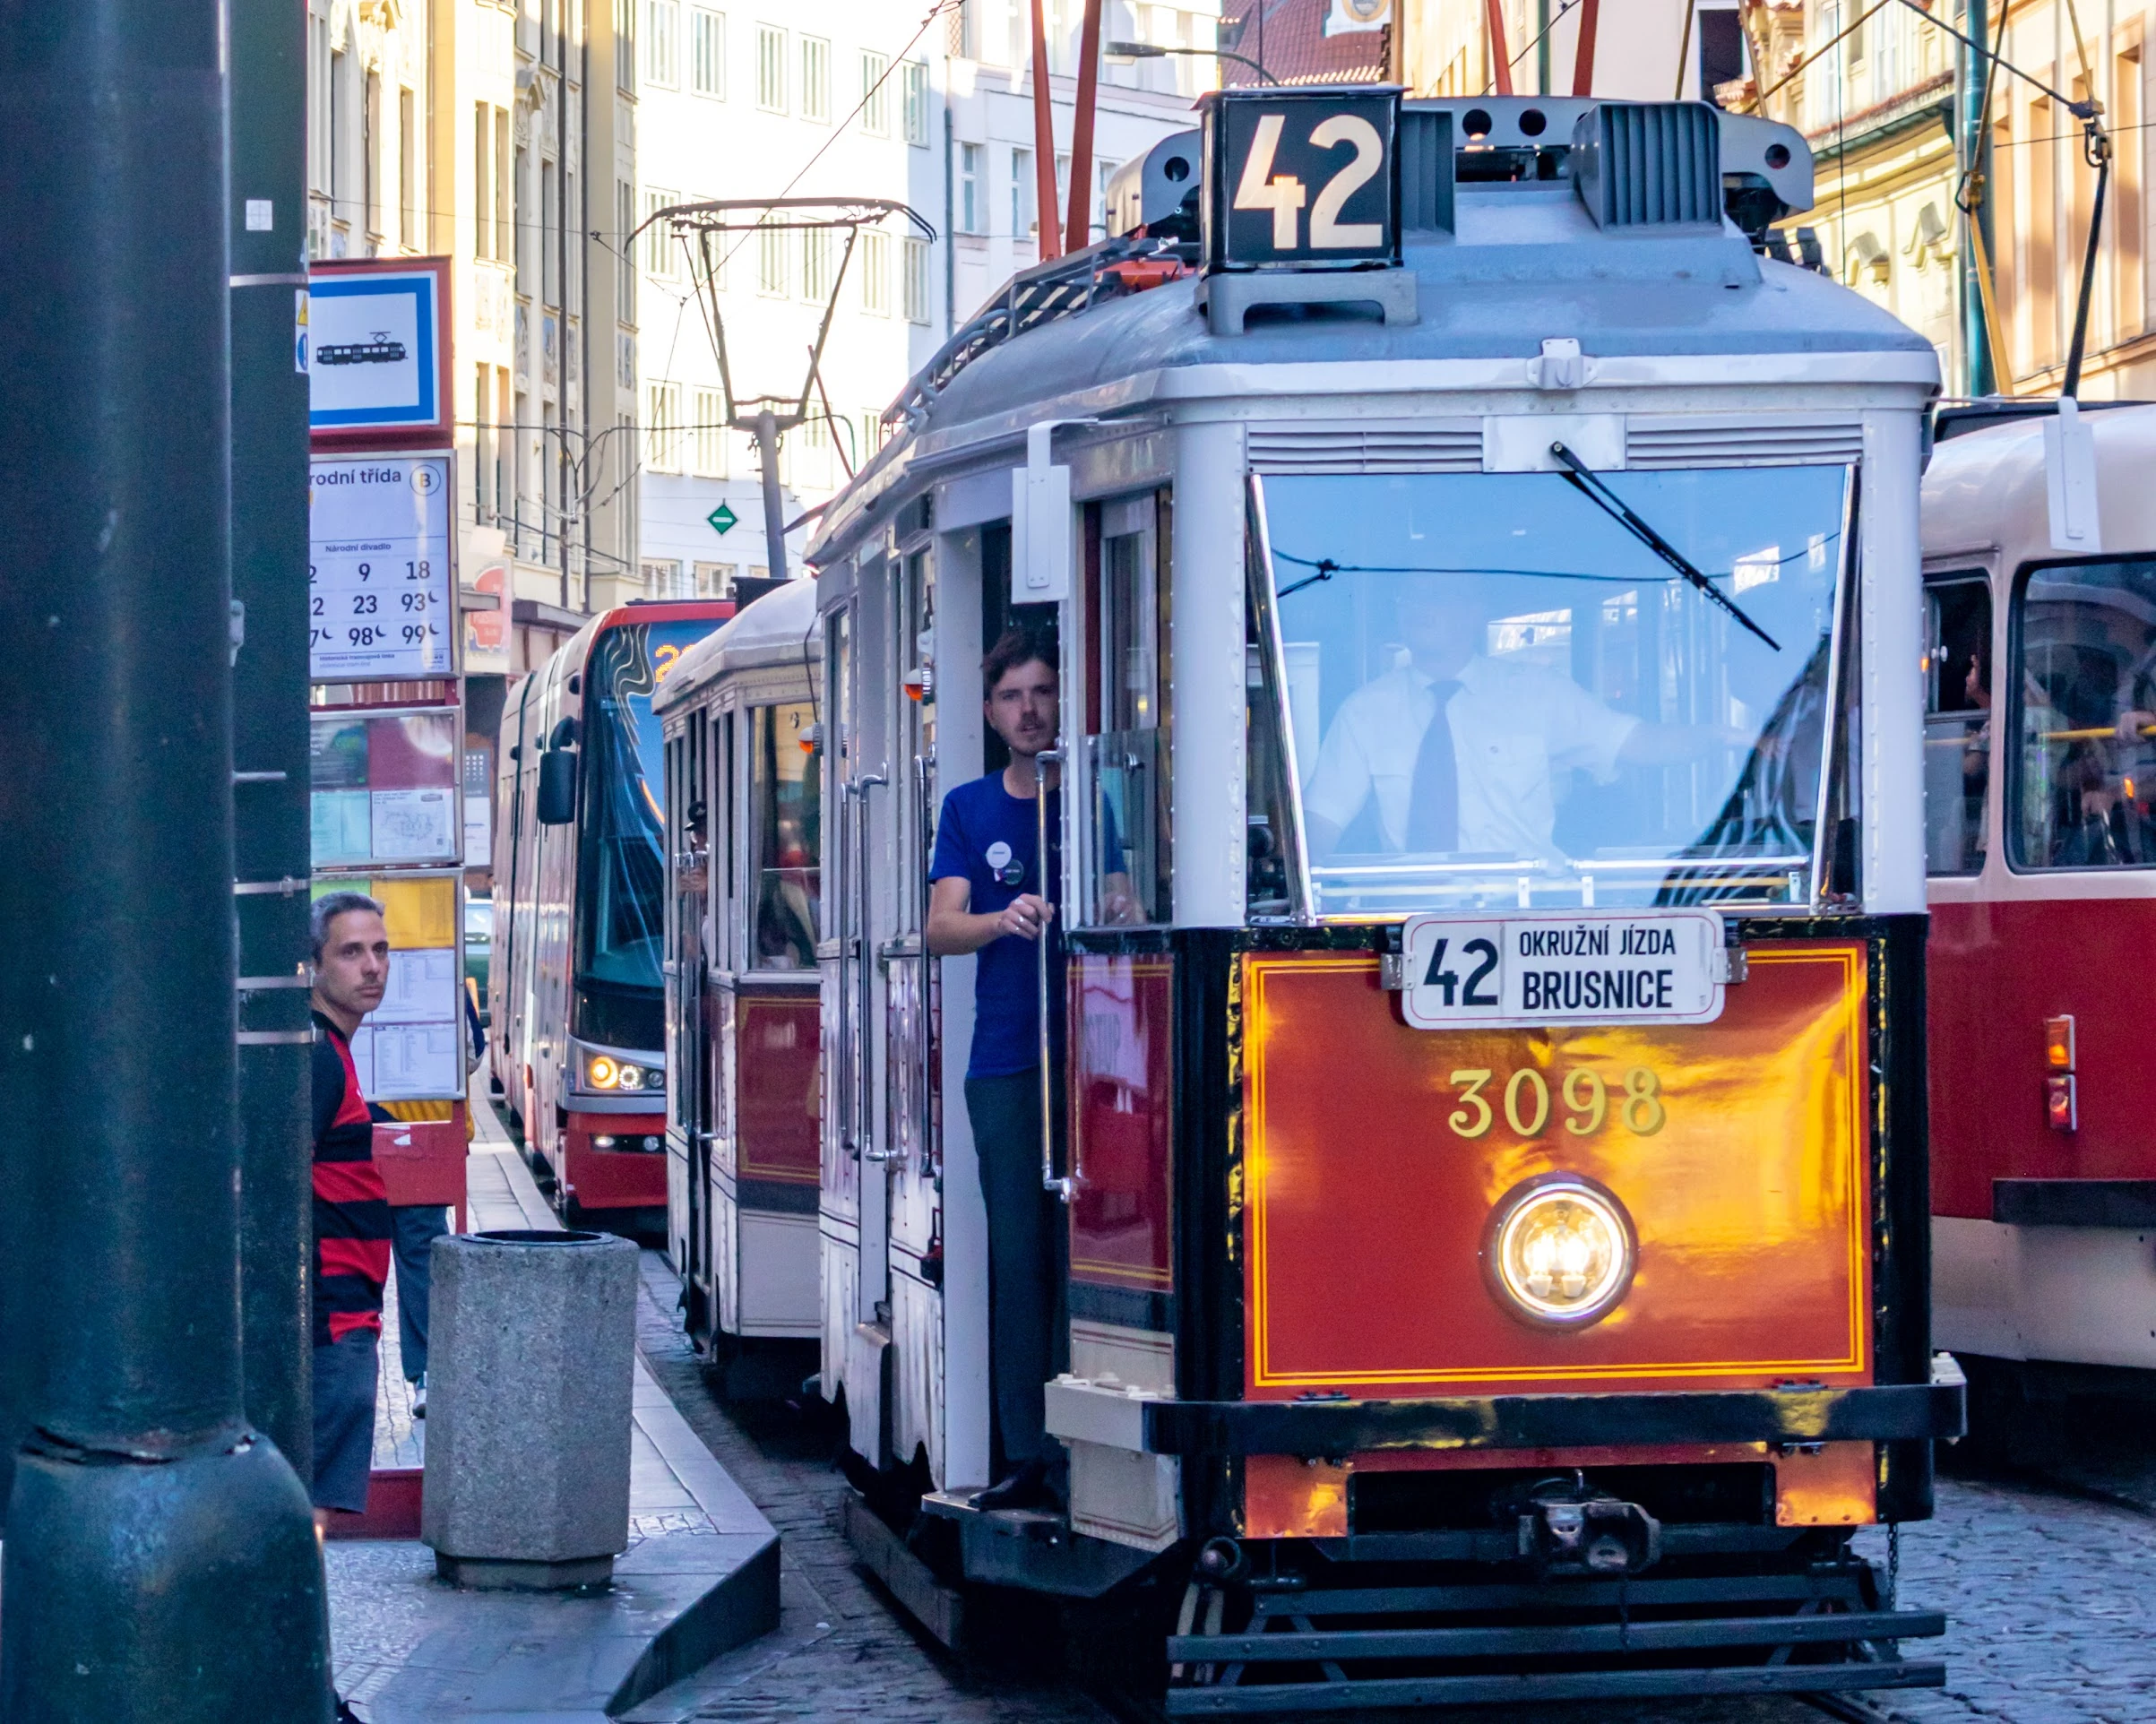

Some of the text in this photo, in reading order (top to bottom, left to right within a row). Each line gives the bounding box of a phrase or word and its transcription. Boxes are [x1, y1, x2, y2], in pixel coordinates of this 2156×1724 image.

[1233, 114, 1384, 250] 42
[360, 468, 401, 484] třída
[419, 472, 431, 488] B
[325, 543, 392, 553] Národní divadlo
[358, 563, 371, 582] 9
[406, 561, 430, 580] 18
[352, 595, 378, 615] 23
[401, 592, 426, 613] 93
[349, 627, 374, 647] 98
[401, 625, 427, 645] 99
[655, 644, 696, 683] 2
[1519, 924, 1609, 957] OKRUŽNÍ
[1619, 923, 1677, 956] JÍZDA
[1423, 937, 1499, 1007] 42
[1522, 969, 1673, 1011] BRUSNICE
[1448, 1067, 1664, 1138] 3098
